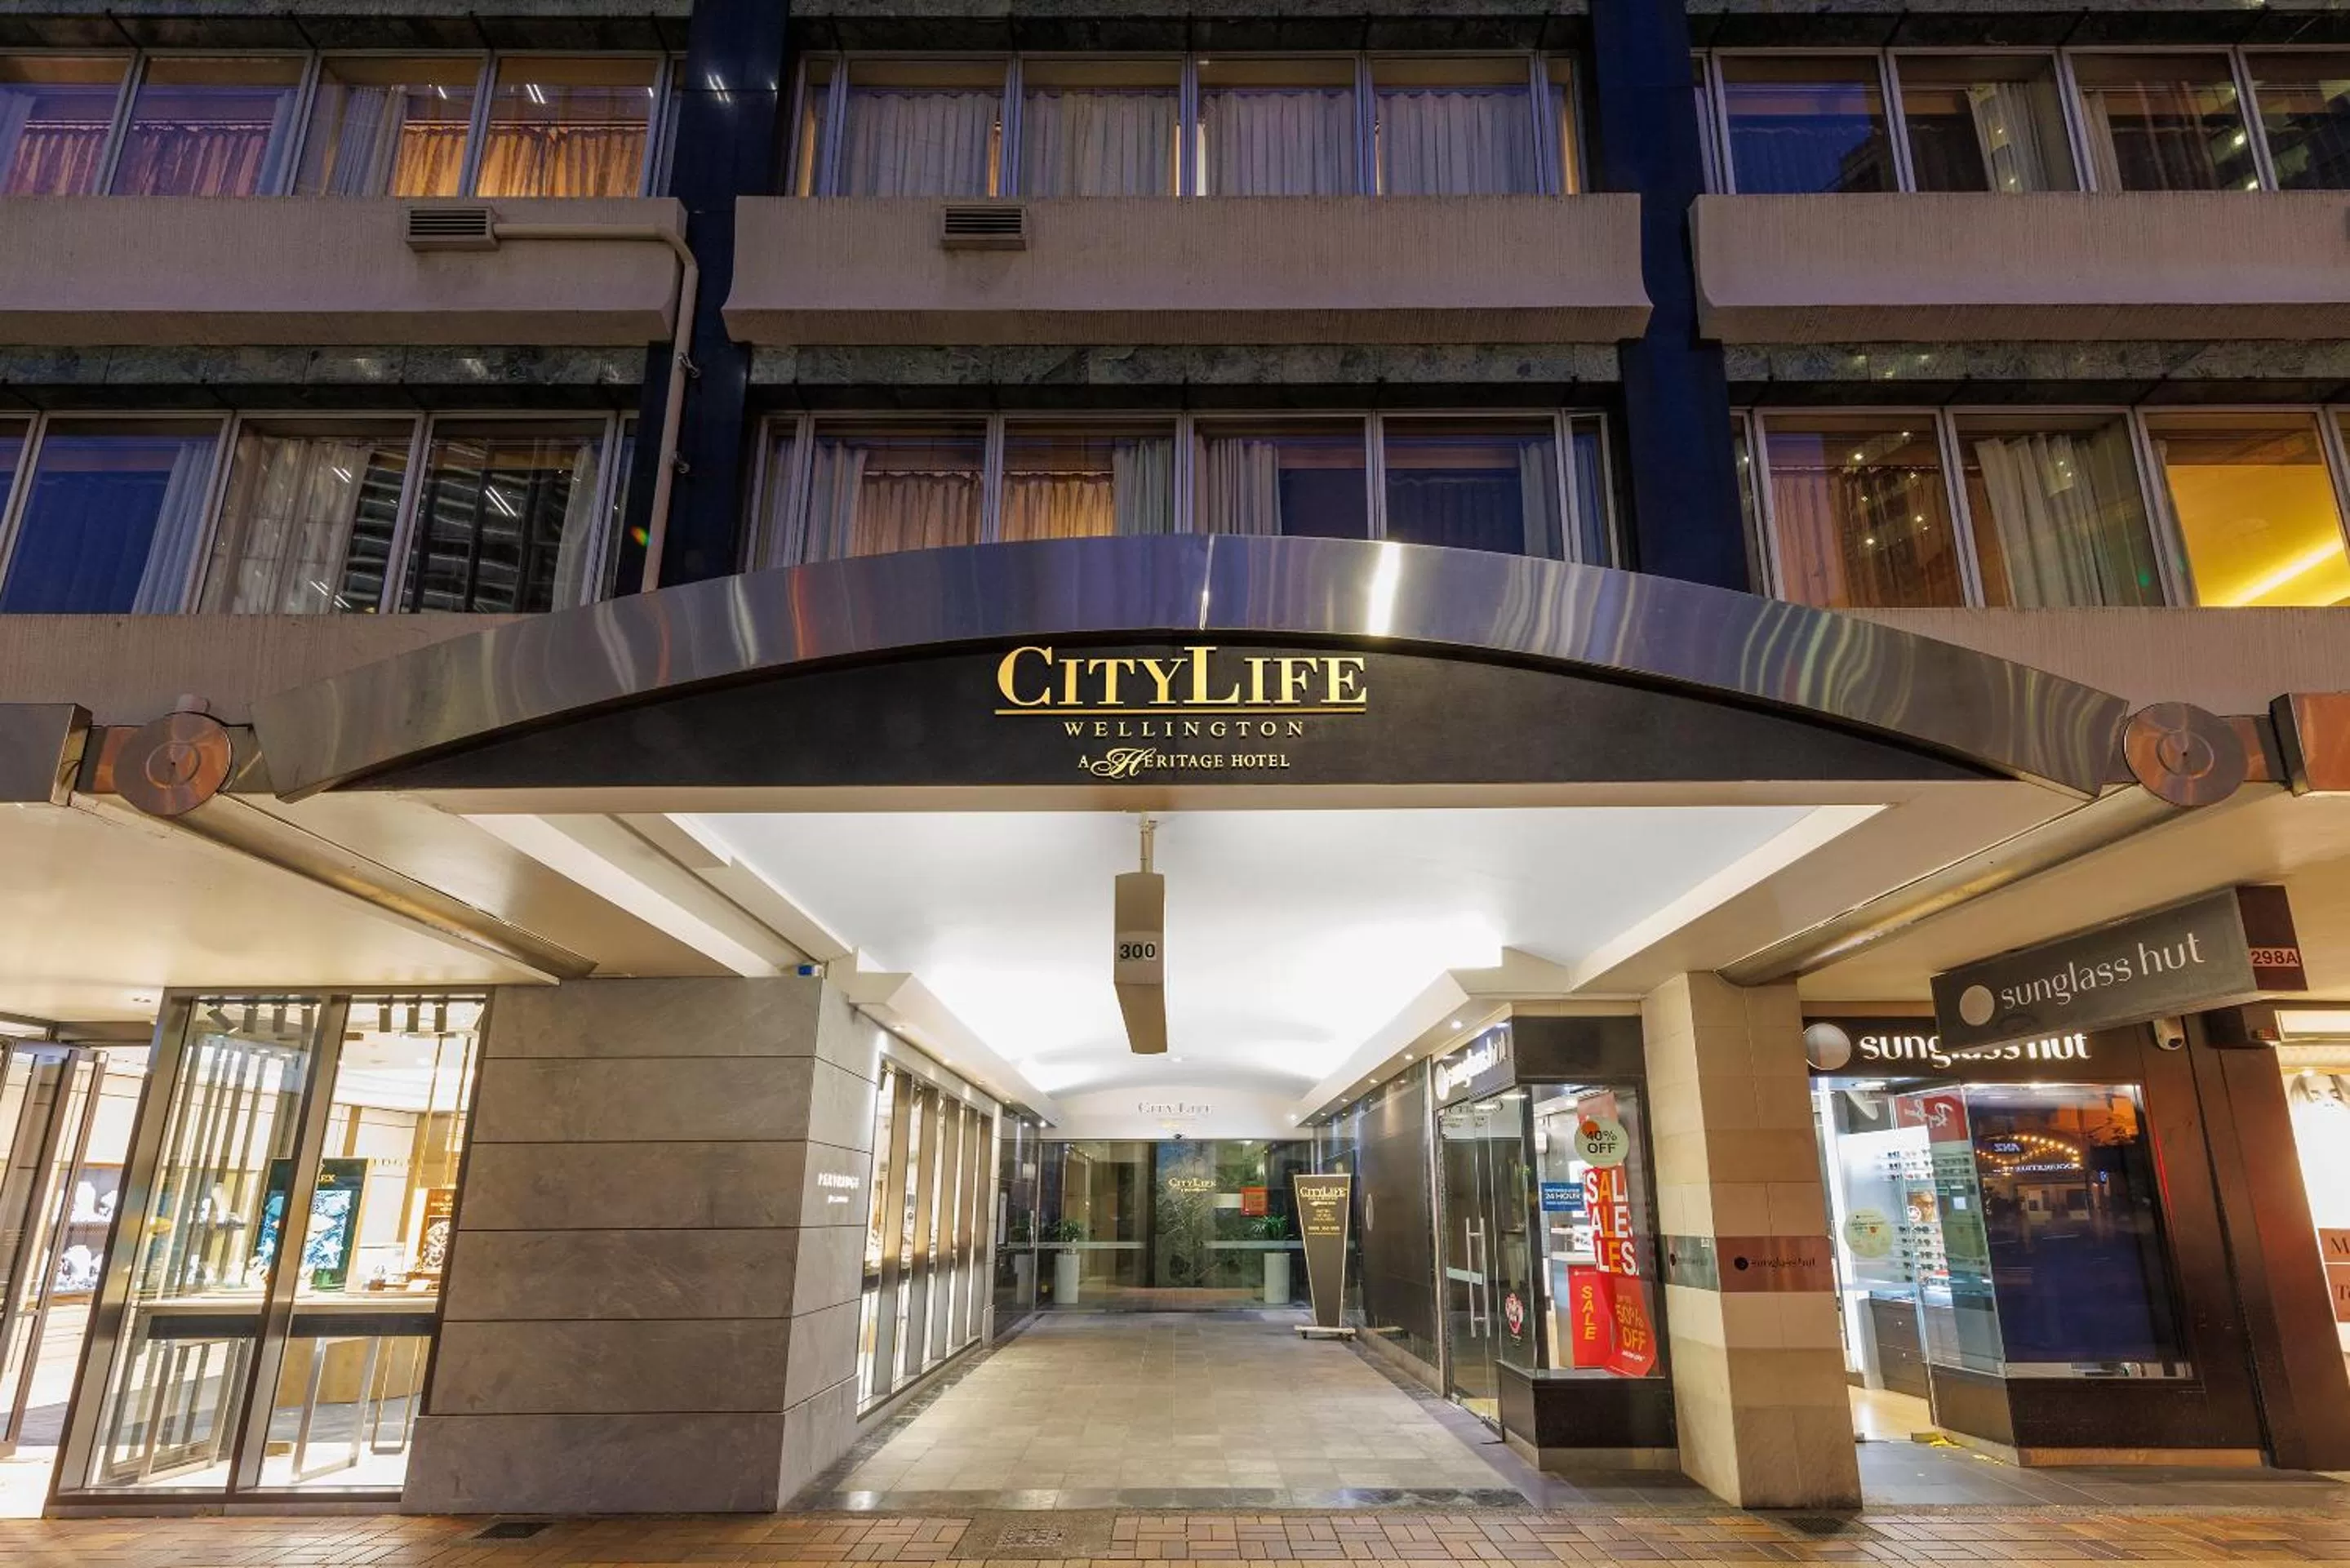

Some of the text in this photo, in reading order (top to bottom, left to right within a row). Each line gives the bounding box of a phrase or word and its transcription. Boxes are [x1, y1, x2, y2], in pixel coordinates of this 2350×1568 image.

[1064, 721, 1305, 737] WELLINGTON
[1077, 754, 1090, 769] A
[1231, 753, 1291, 769] HOTEL
[1119, 944, 1156, 959] 300
[2250, 950, 2298, 964] 298A
[2001, 932, 2206, 1010] sunglass hut
[1859, 1033, 2021, 1068] sung
[1587, 1143, 1616, 1153] OFF
[1586, 1170, 1628, 1204] SAL
[1581, 1286, 1597, 1340] SALE
[1622, 1326, 1647, 1352] OFF
